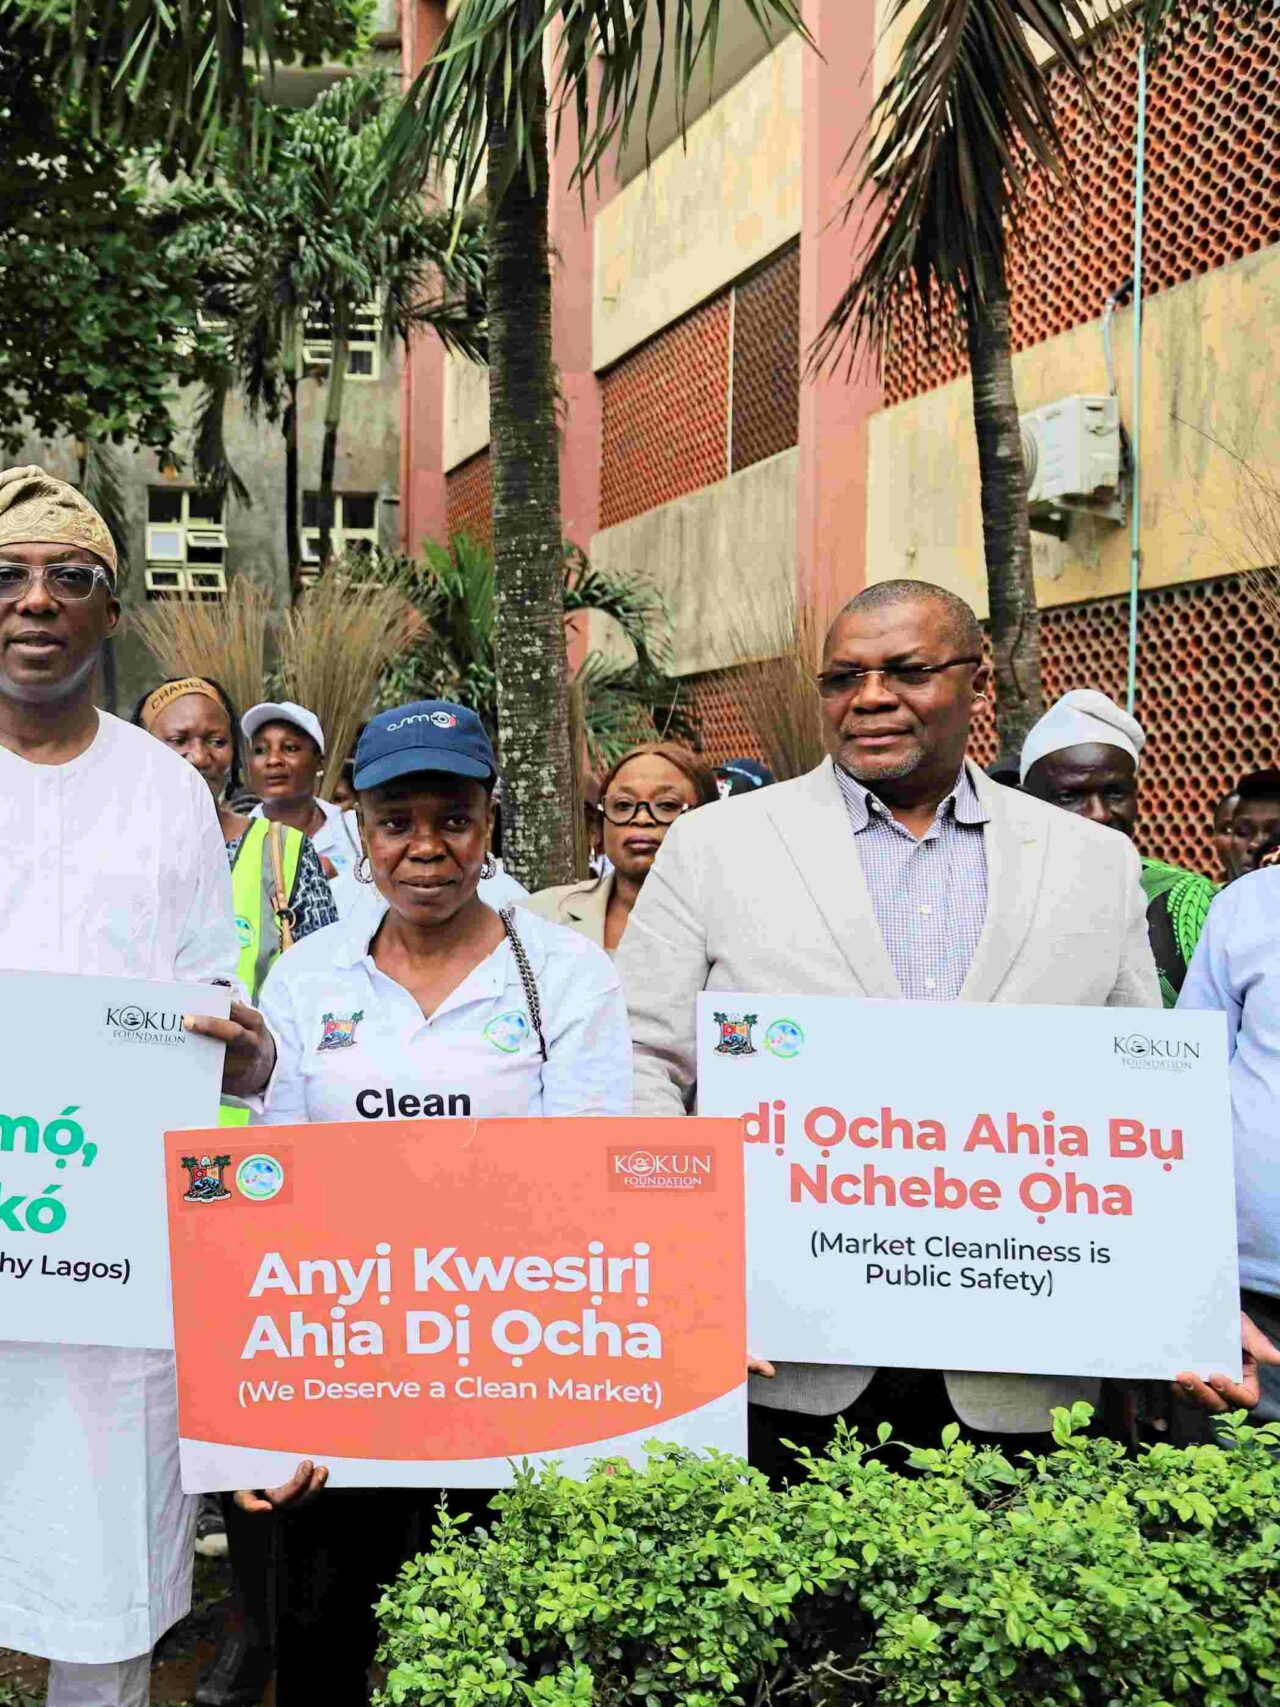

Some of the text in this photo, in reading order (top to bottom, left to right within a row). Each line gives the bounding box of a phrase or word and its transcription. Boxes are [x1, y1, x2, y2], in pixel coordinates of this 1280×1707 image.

[113, 1030, 186, 1044] FOUNDATION
[1114, 1034, 1200, 1058] KOKUN
[355, 1088, 472, 1120] Clean
[804, 1105, 947, 1158] Ọcha
[964, 1110, 1090, 1167] Ahịa
[1109, 1117, 1184, 1172] Bụ
[613, 1150, 711, 1177] KOKUN
[624, 1176, 703, 1186] FOUNDATION
[789, 1162, 1134, 1224] Nchebe Ọha
[810, 1230, 1111, 1265] (Market Cleanliness is
[41, 1254, 131, 1285] Lagos)
[248, 1241, 651, 1307] Anyị Kwesịrị
[865, 1262, 1054, 1297] Public Safety)
[240, 1304, 663, 1368] Ahịa Dị Ọcha
[238, 1375, 663, 1408] (We Deserve a Clean Market)
